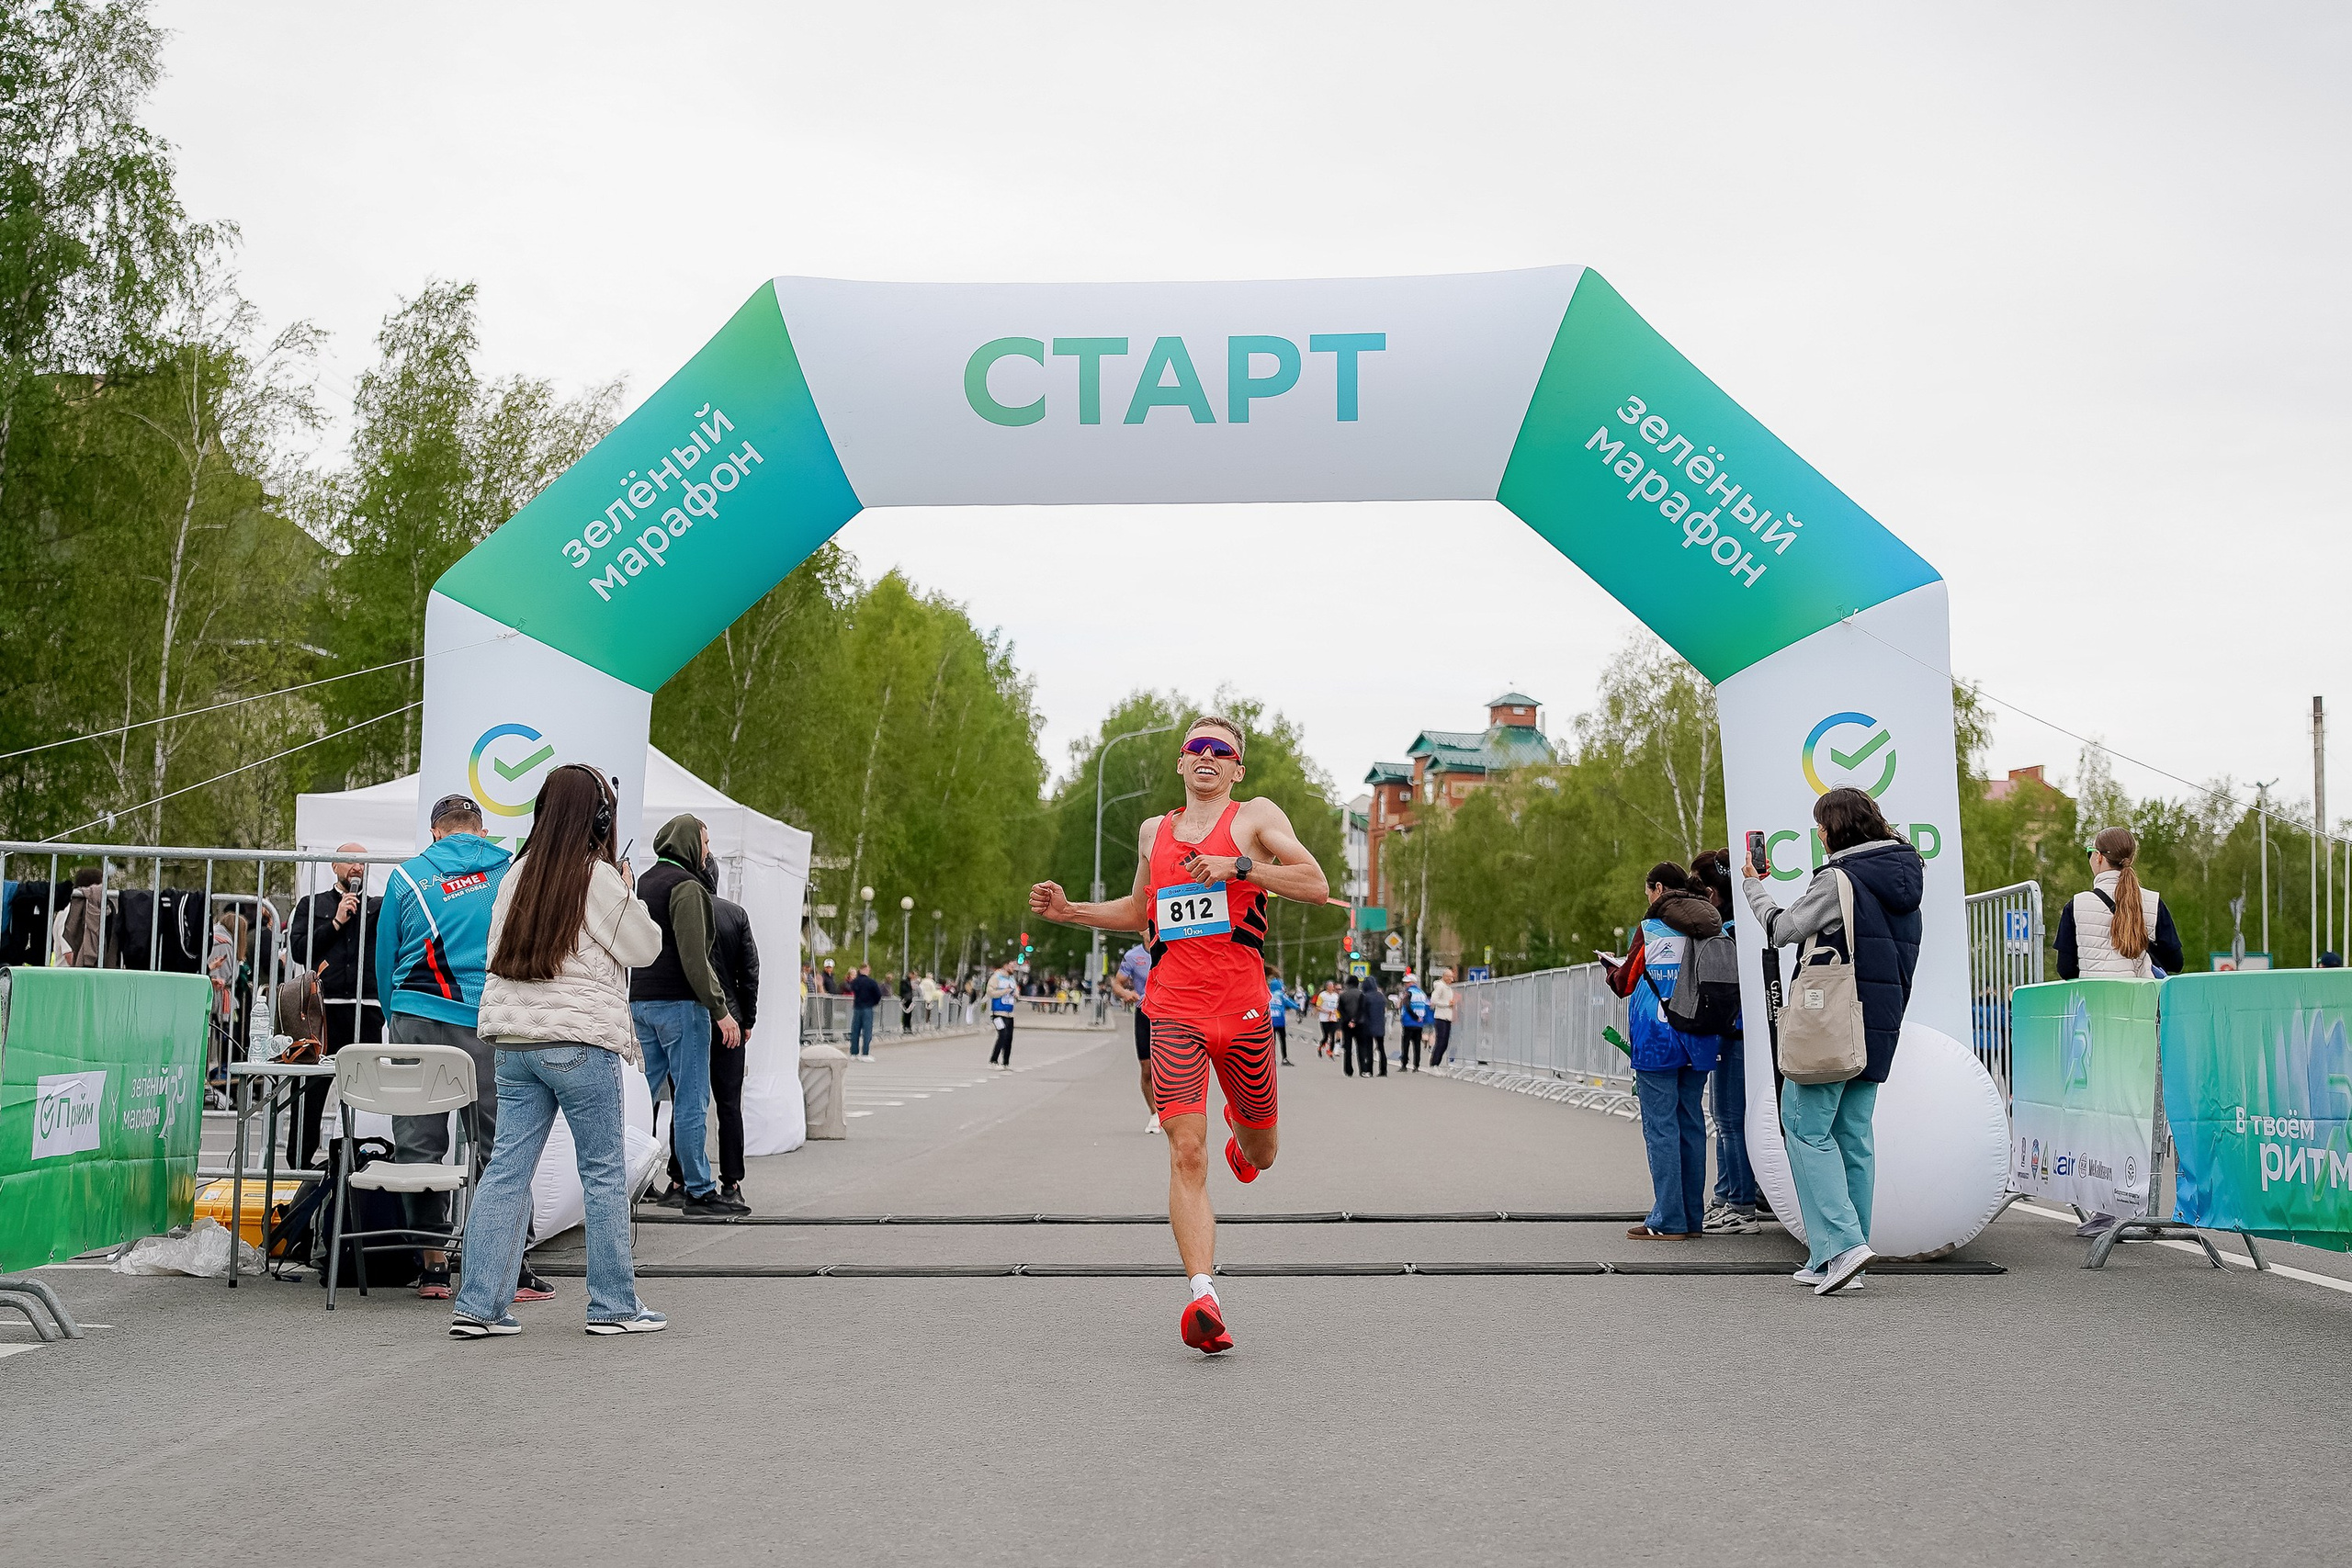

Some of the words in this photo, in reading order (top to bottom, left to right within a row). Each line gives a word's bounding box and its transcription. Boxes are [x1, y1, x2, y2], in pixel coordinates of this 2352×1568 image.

[964, 333, 1386, 427] СТАРТ
[561, 401, 736, 570] зелёный
[1584, 424, 1768, 589] марафон
[1616, 394, 1804, 556] зелёный
[588, 440, 764, 603] марафон
[447, 874, 481, 891] TIME
[1766, 823, 1941, 882] СР
[442, 890, 465, 903] ВРЕМЯ
[1170, 897, 1214, 922] 812
[2235, 1106, 2245, 1134] В
[2249, 1109, 2314, 1141] твоём
